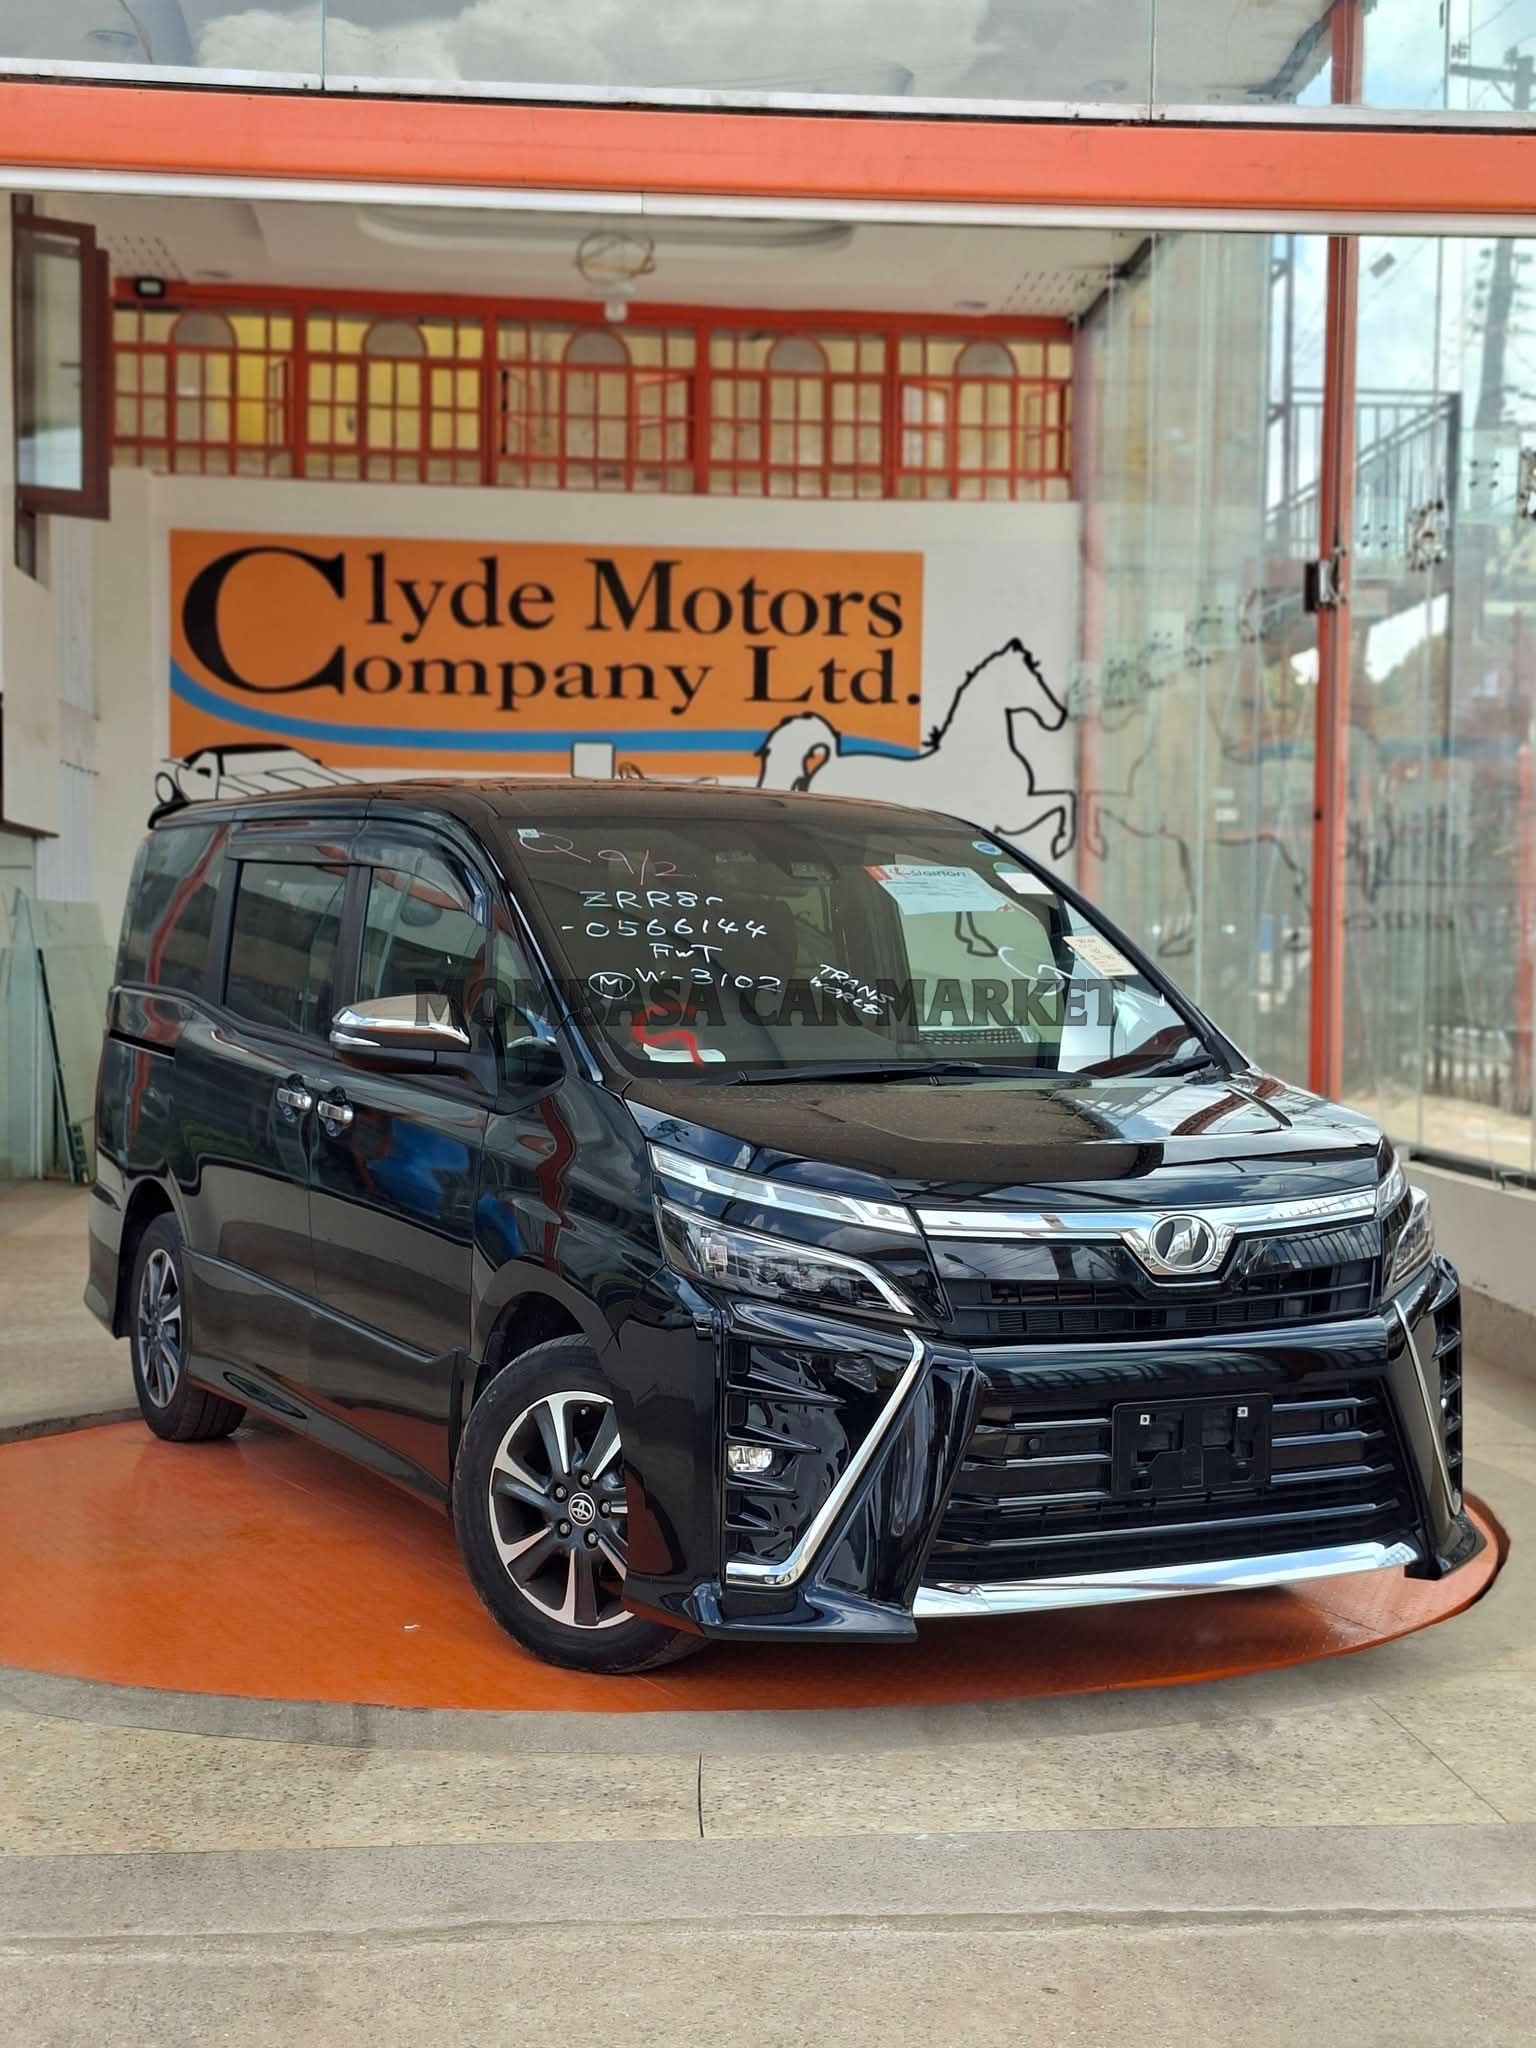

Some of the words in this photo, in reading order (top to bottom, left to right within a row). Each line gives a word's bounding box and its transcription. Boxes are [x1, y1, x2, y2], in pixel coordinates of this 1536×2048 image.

[182, 546, 555, 694] Clyde
[586, 557, 903, 638] Motors
[745, 644, 921, 706] Ltd.
